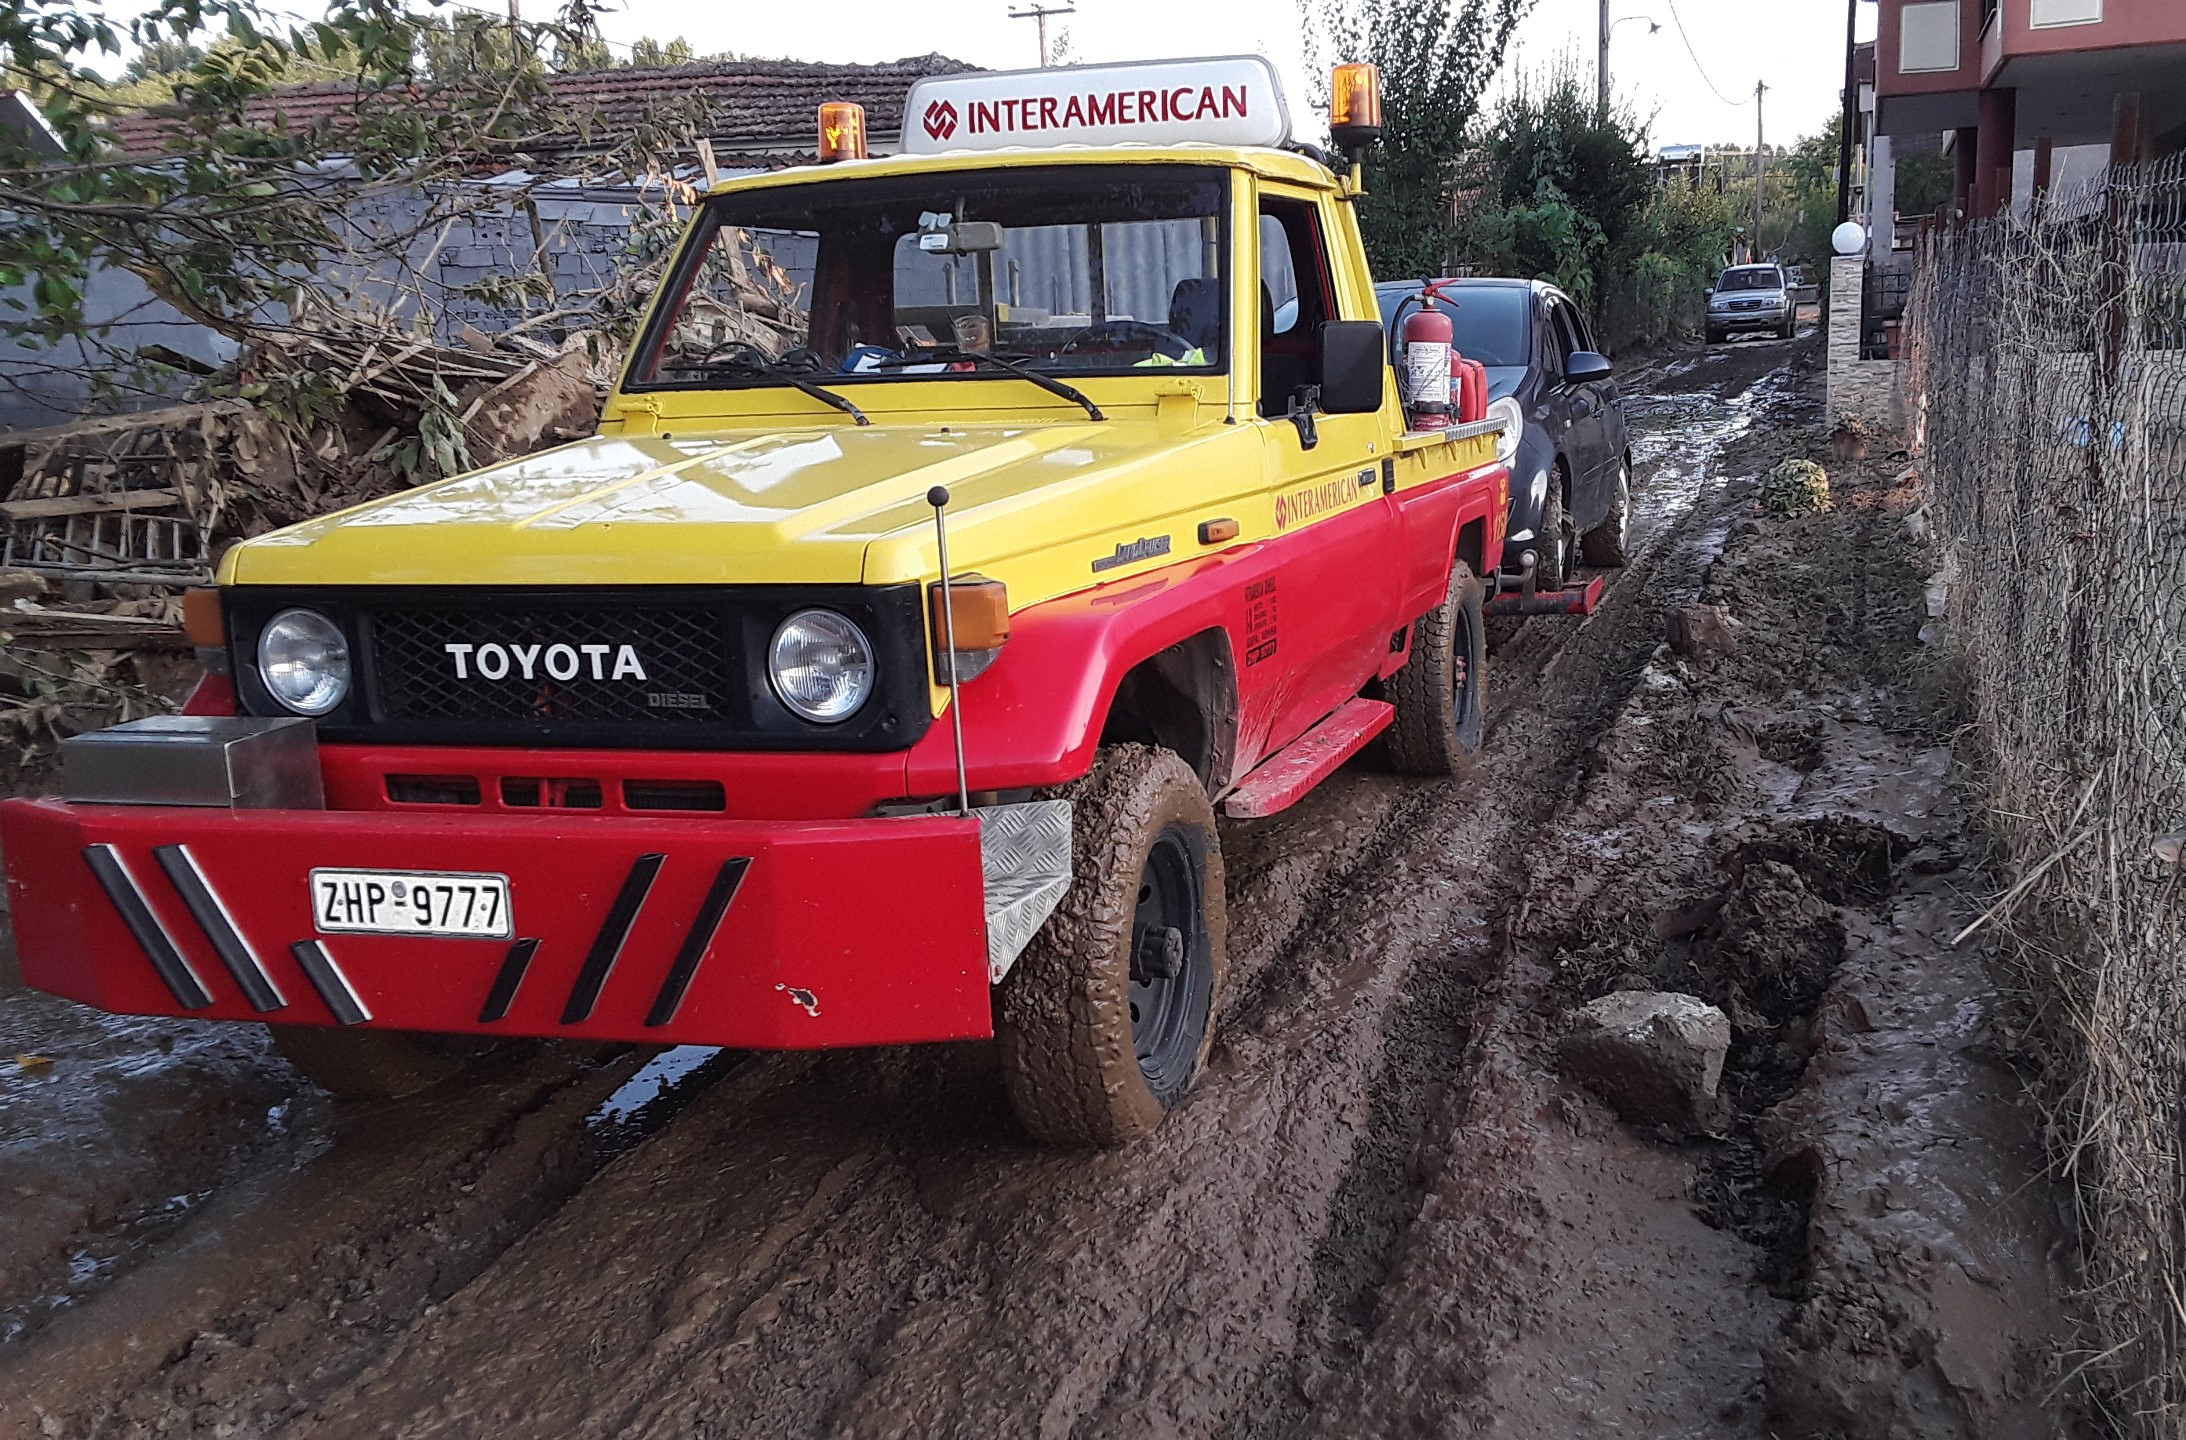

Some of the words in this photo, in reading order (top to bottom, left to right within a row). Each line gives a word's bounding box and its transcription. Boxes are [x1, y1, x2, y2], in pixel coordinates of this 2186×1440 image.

[968, 85, 1247, 134] INTERAMERICAN
[1287, 476, 1358, 523] INTERAMERICAN
[445, 643, 647, 681] TOYOTA
[648, 692, 711, 709] DIESEL
